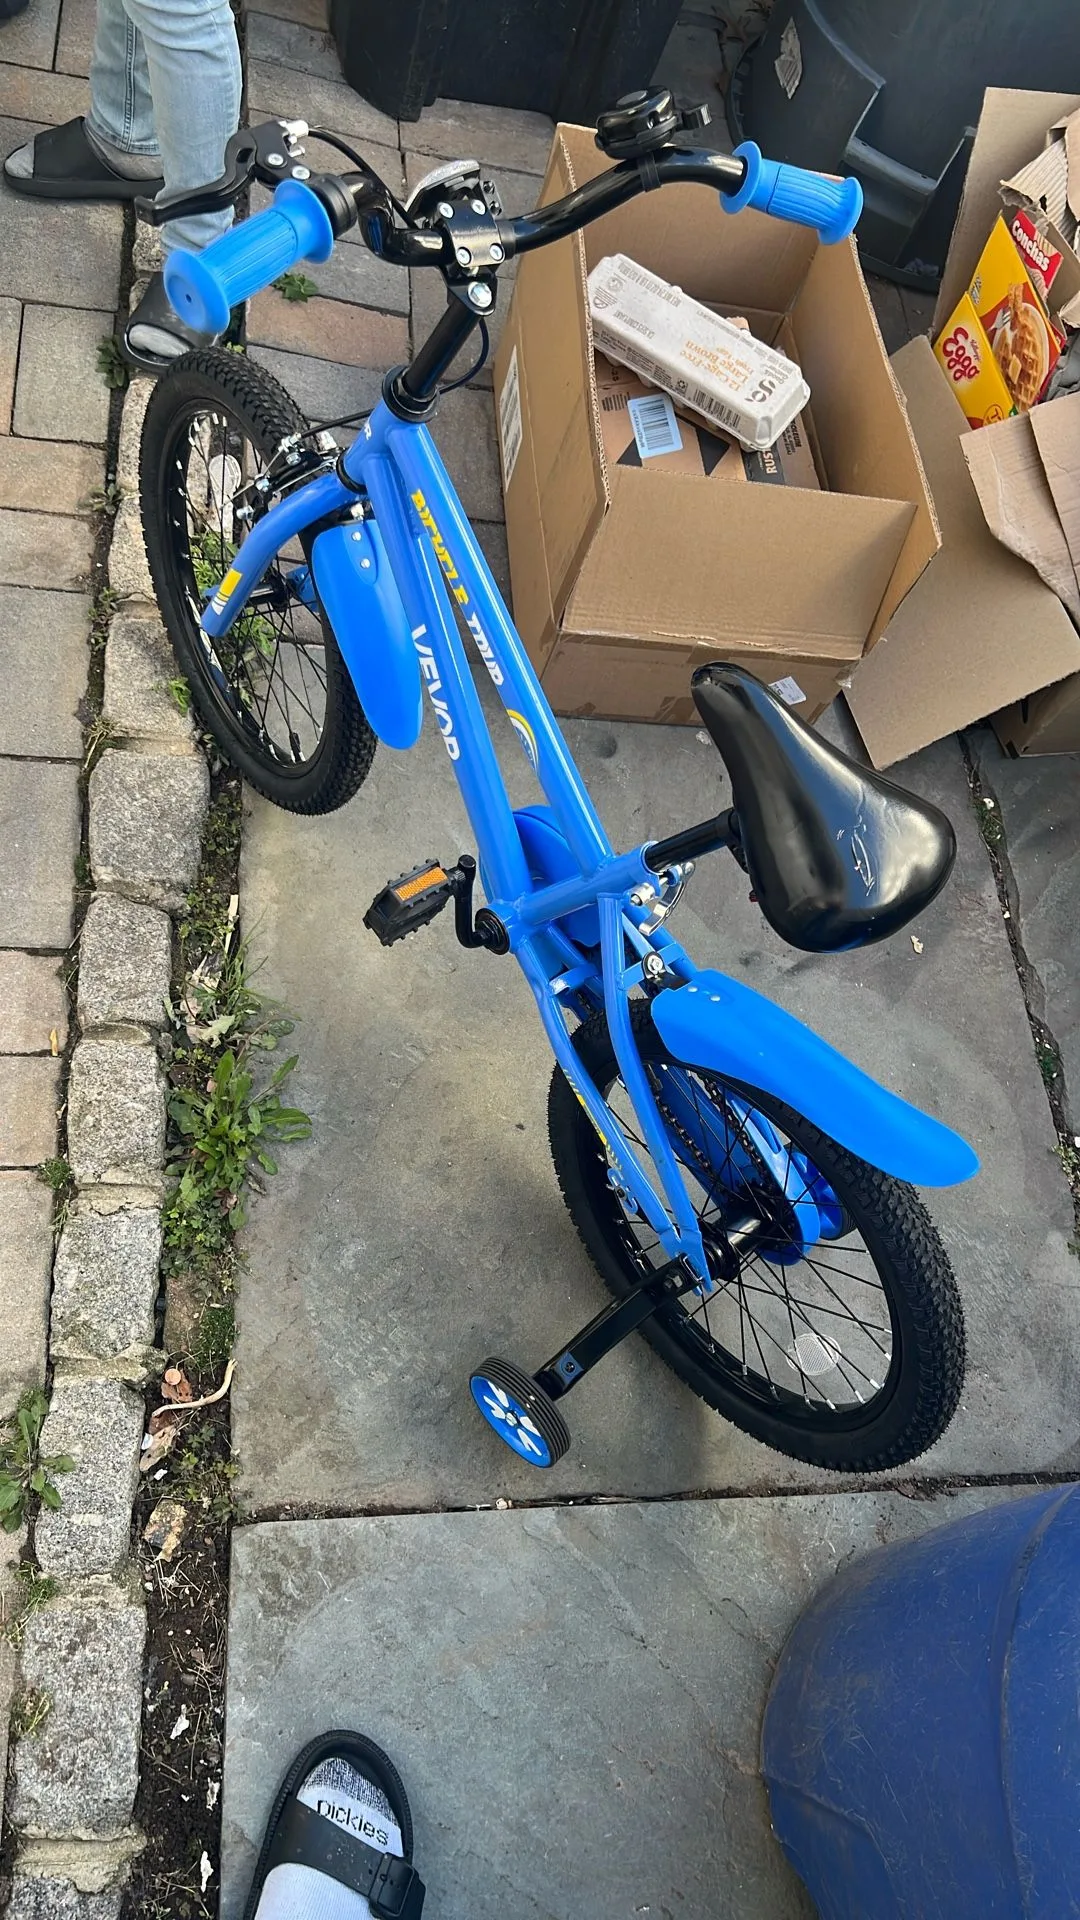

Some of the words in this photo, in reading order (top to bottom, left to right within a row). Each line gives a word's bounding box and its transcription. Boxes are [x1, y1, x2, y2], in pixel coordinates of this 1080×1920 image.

[1011, 220, 1050, 271] Conchas
[686, 340, 719, 363] Brown
[718, 359, 749, 382] Large
[943, 327, 980, 381] Eggo
[316, 1800, 389, 1846] Dickies
